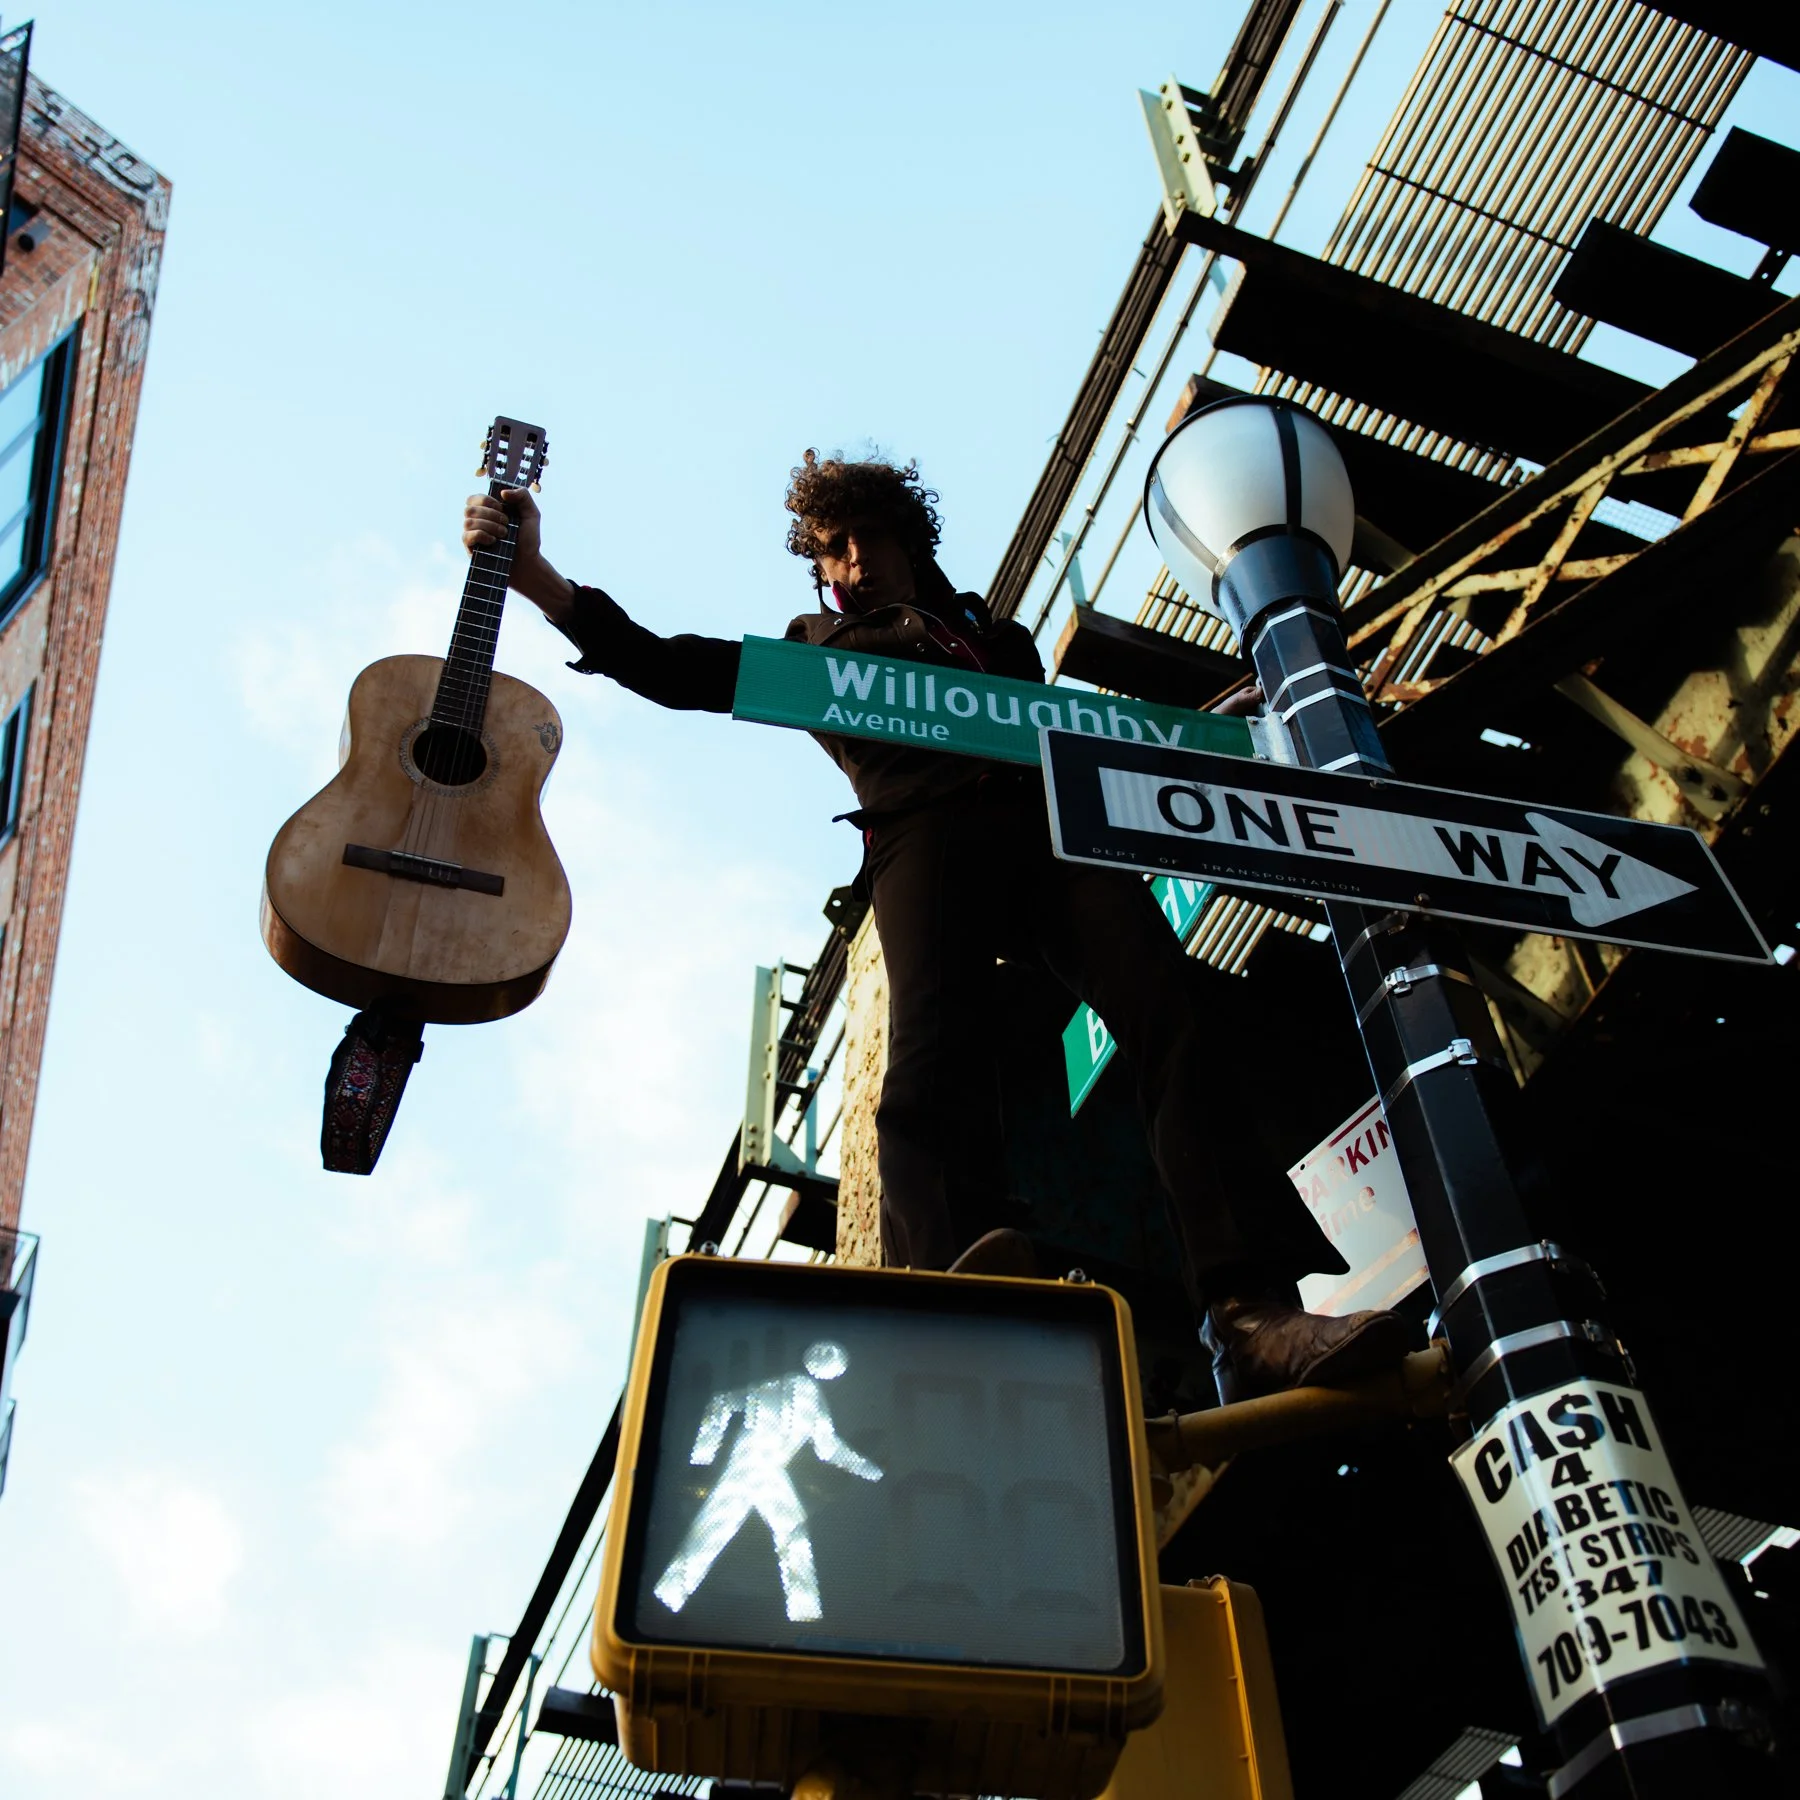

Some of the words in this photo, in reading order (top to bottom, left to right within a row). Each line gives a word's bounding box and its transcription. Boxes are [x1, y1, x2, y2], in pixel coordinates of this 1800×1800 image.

[822, 702, 950, 741] Avenue
[825, 656, 1184, 747] Willoughby
[1092, 846, 1138, 861] DEPT
[1158, 856, 1179, 866] OF
[1202, 862, 1362, 893] TRANSPORTATION
[1157, 783, 1355, 857] ONE
[1434, 825, 1622, 899] WAY
[1550, 1452, 1593, 1490] 4
[1506, 1479, 1680, 1581] DIABETIC
[1518, 1544, 1576, 1617] TEST
[1580, 1522, 1700, 1567] STRIPS
[1561, 1560, 1663, 1614] 347
[1536, 1593, 1739, 1701] 709-7043
